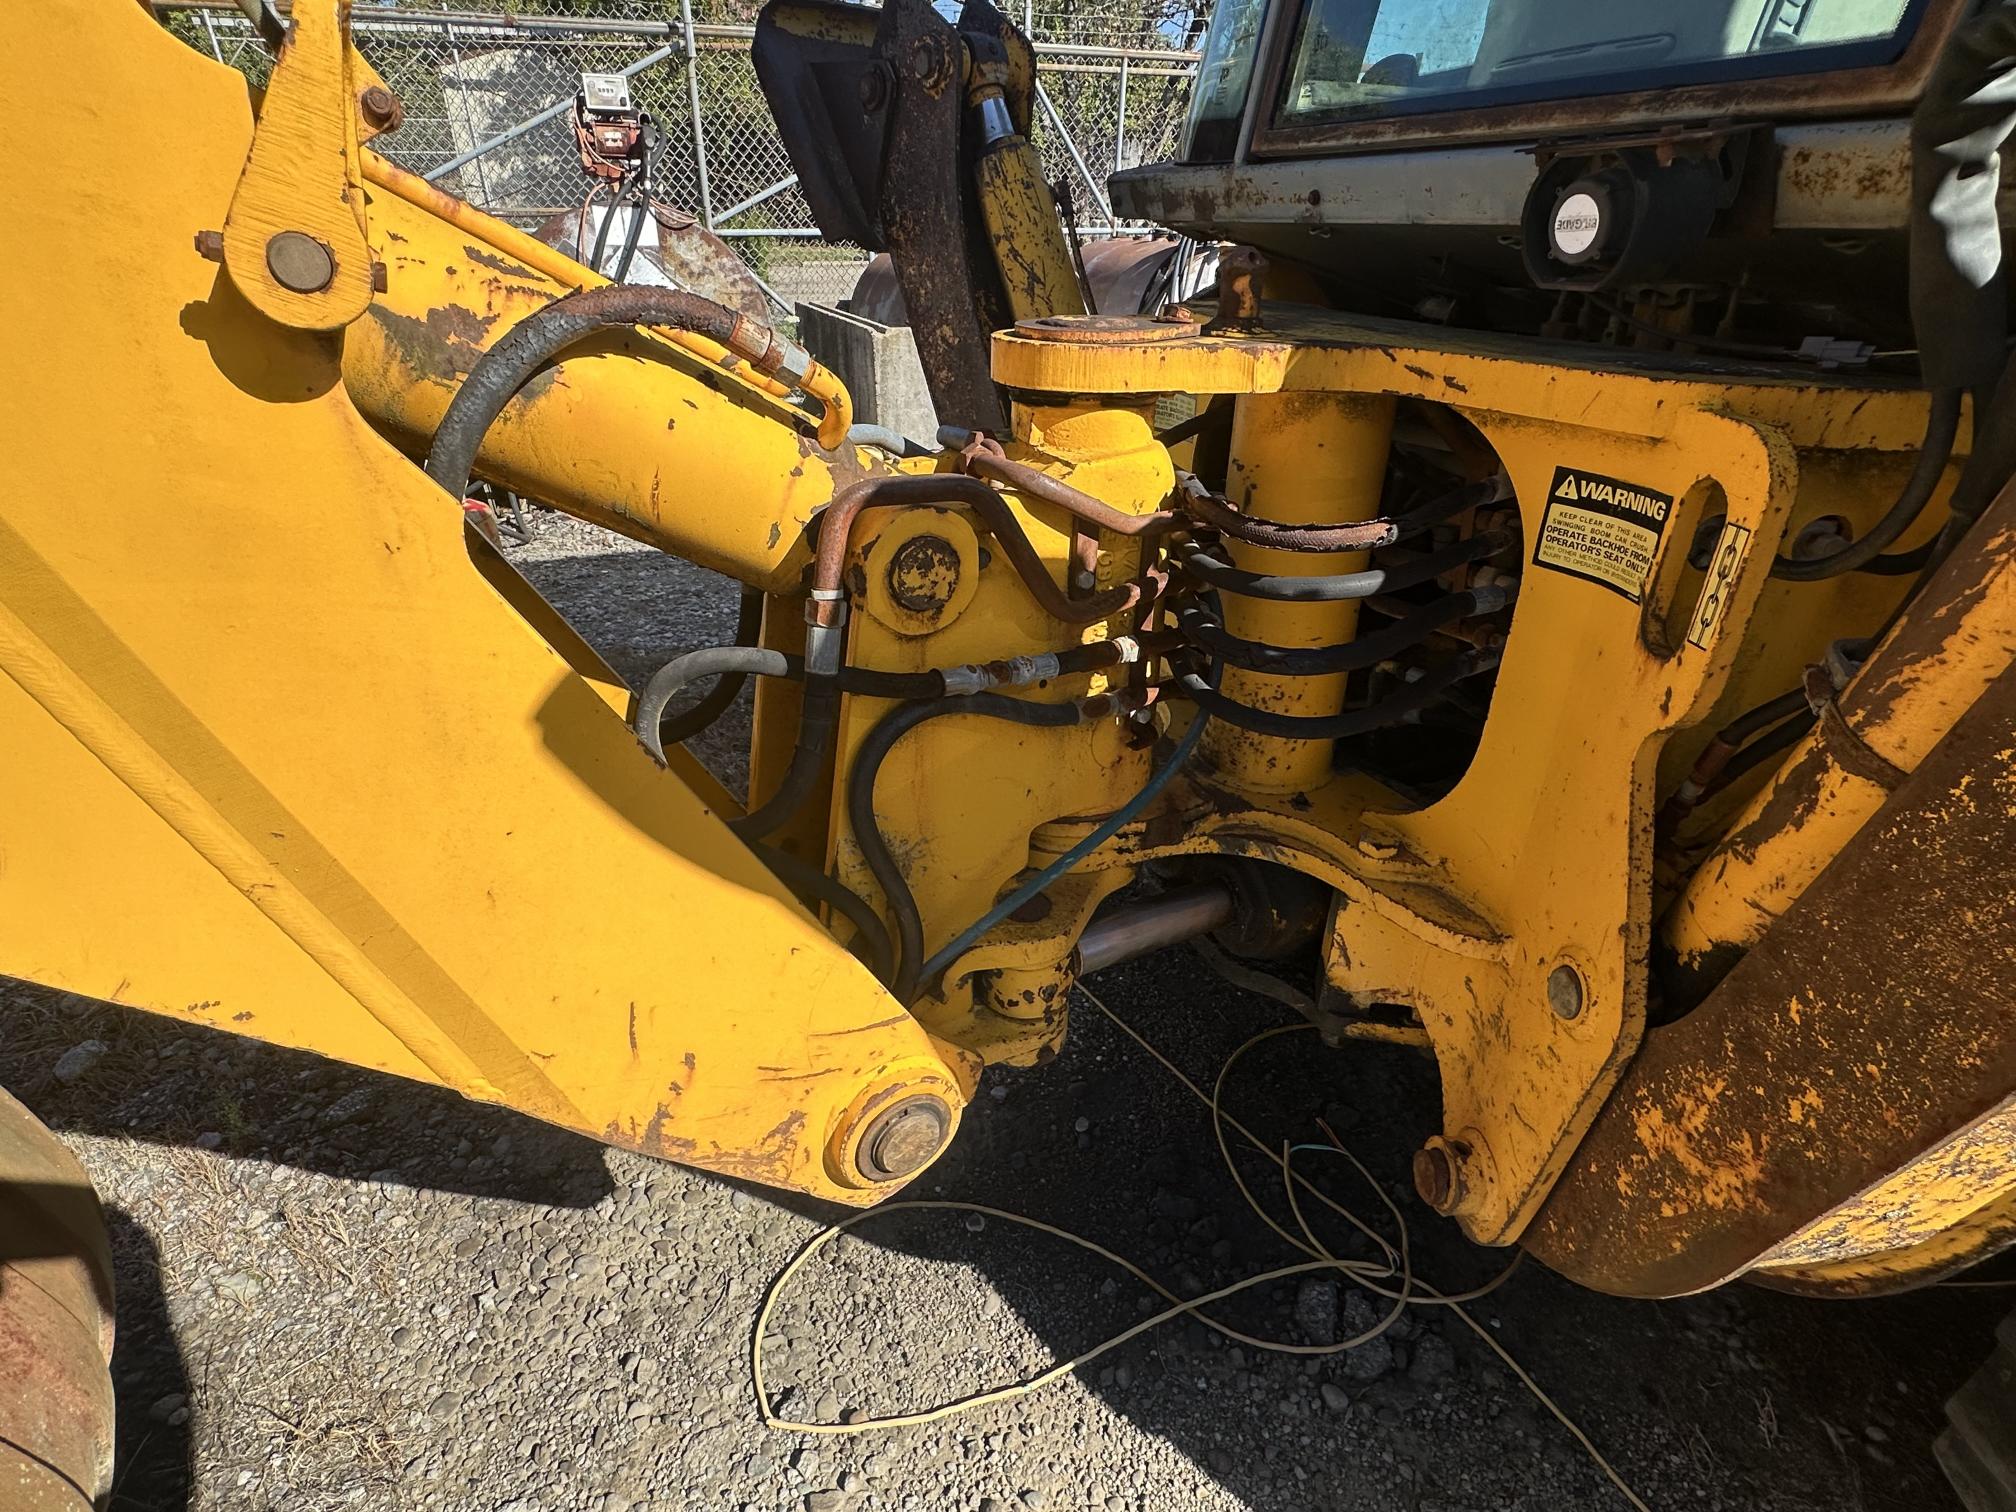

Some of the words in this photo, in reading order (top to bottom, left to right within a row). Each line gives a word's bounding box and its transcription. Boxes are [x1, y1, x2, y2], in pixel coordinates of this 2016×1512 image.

[1581, 480, 1666, 521] WARNING
[1552, 518, 1586, 532] SWINGING
[1590, 528, 1611, 538] BOOM
[1614, 535, 1627, 544] CAN
[1559, 511, 1577, 520] KEEP
[1579, 516, 1603, 527] CLEAR
[1618, 526, 1630, 536] THIS
[1633, 532, 1647, 542] AREA
[1545, 534, 1602, 556] OPERATOR'S
[1603, 550, 1625, 565] SEAT
[1546, 525, 1587, 542] OPERATE
[1589, 536, 1630, 557] BACKHOE
[1630, 550, 1650, 566] FROM
